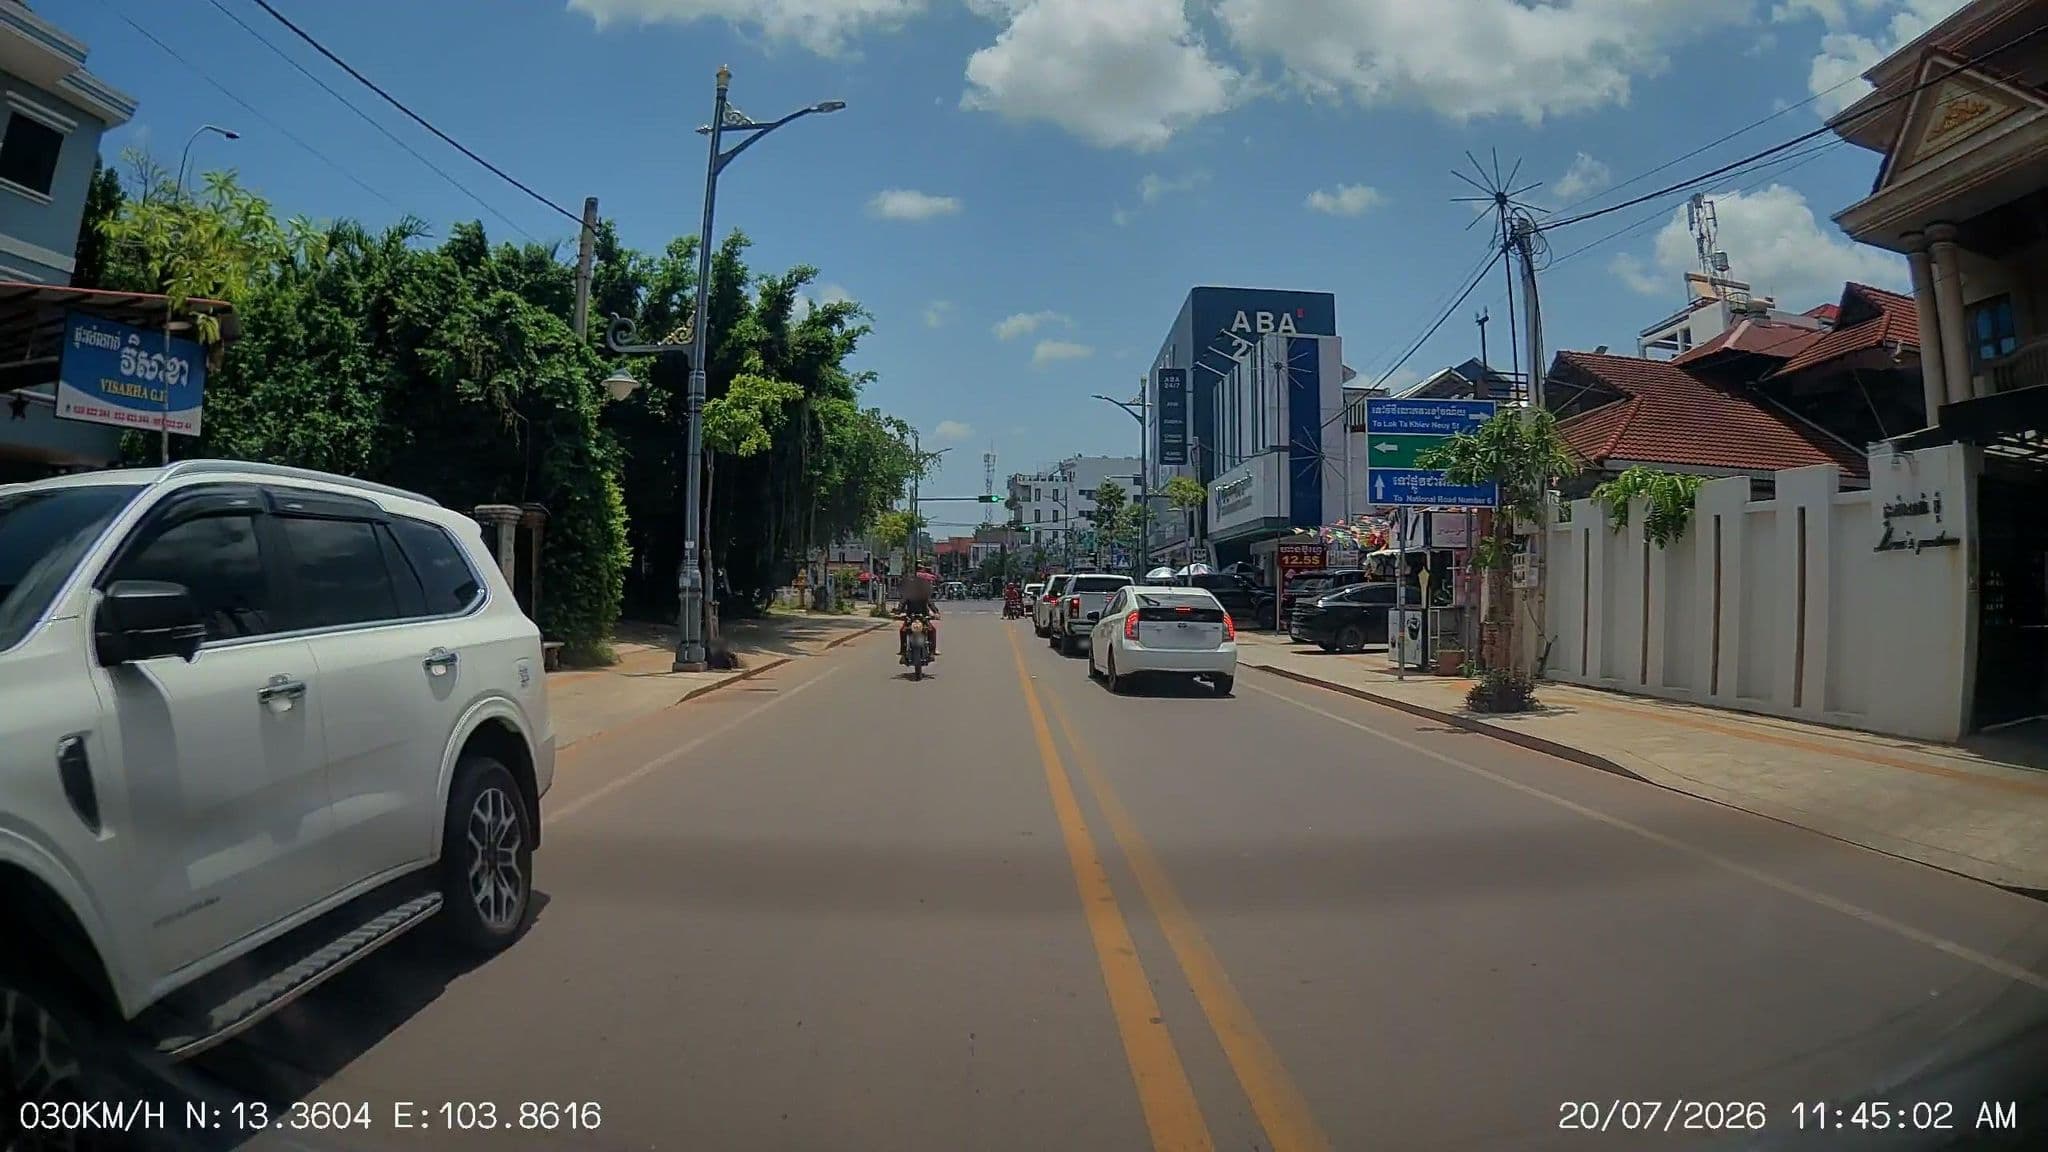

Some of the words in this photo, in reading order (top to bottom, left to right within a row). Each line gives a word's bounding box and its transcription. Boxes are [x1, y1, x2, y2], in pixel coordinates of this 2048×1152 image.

[1230, 310, 1297, 336] ABA
[101, 378, 149, 399] VISAKHA
[1383, 420, 1398, 428] Lok
[1399, 420, 1408, 428] Ta
[1393, 494, 1403, 502] To
[1406, 495, 1436, 503] National
[1458, 496, 1486, 504] Number
